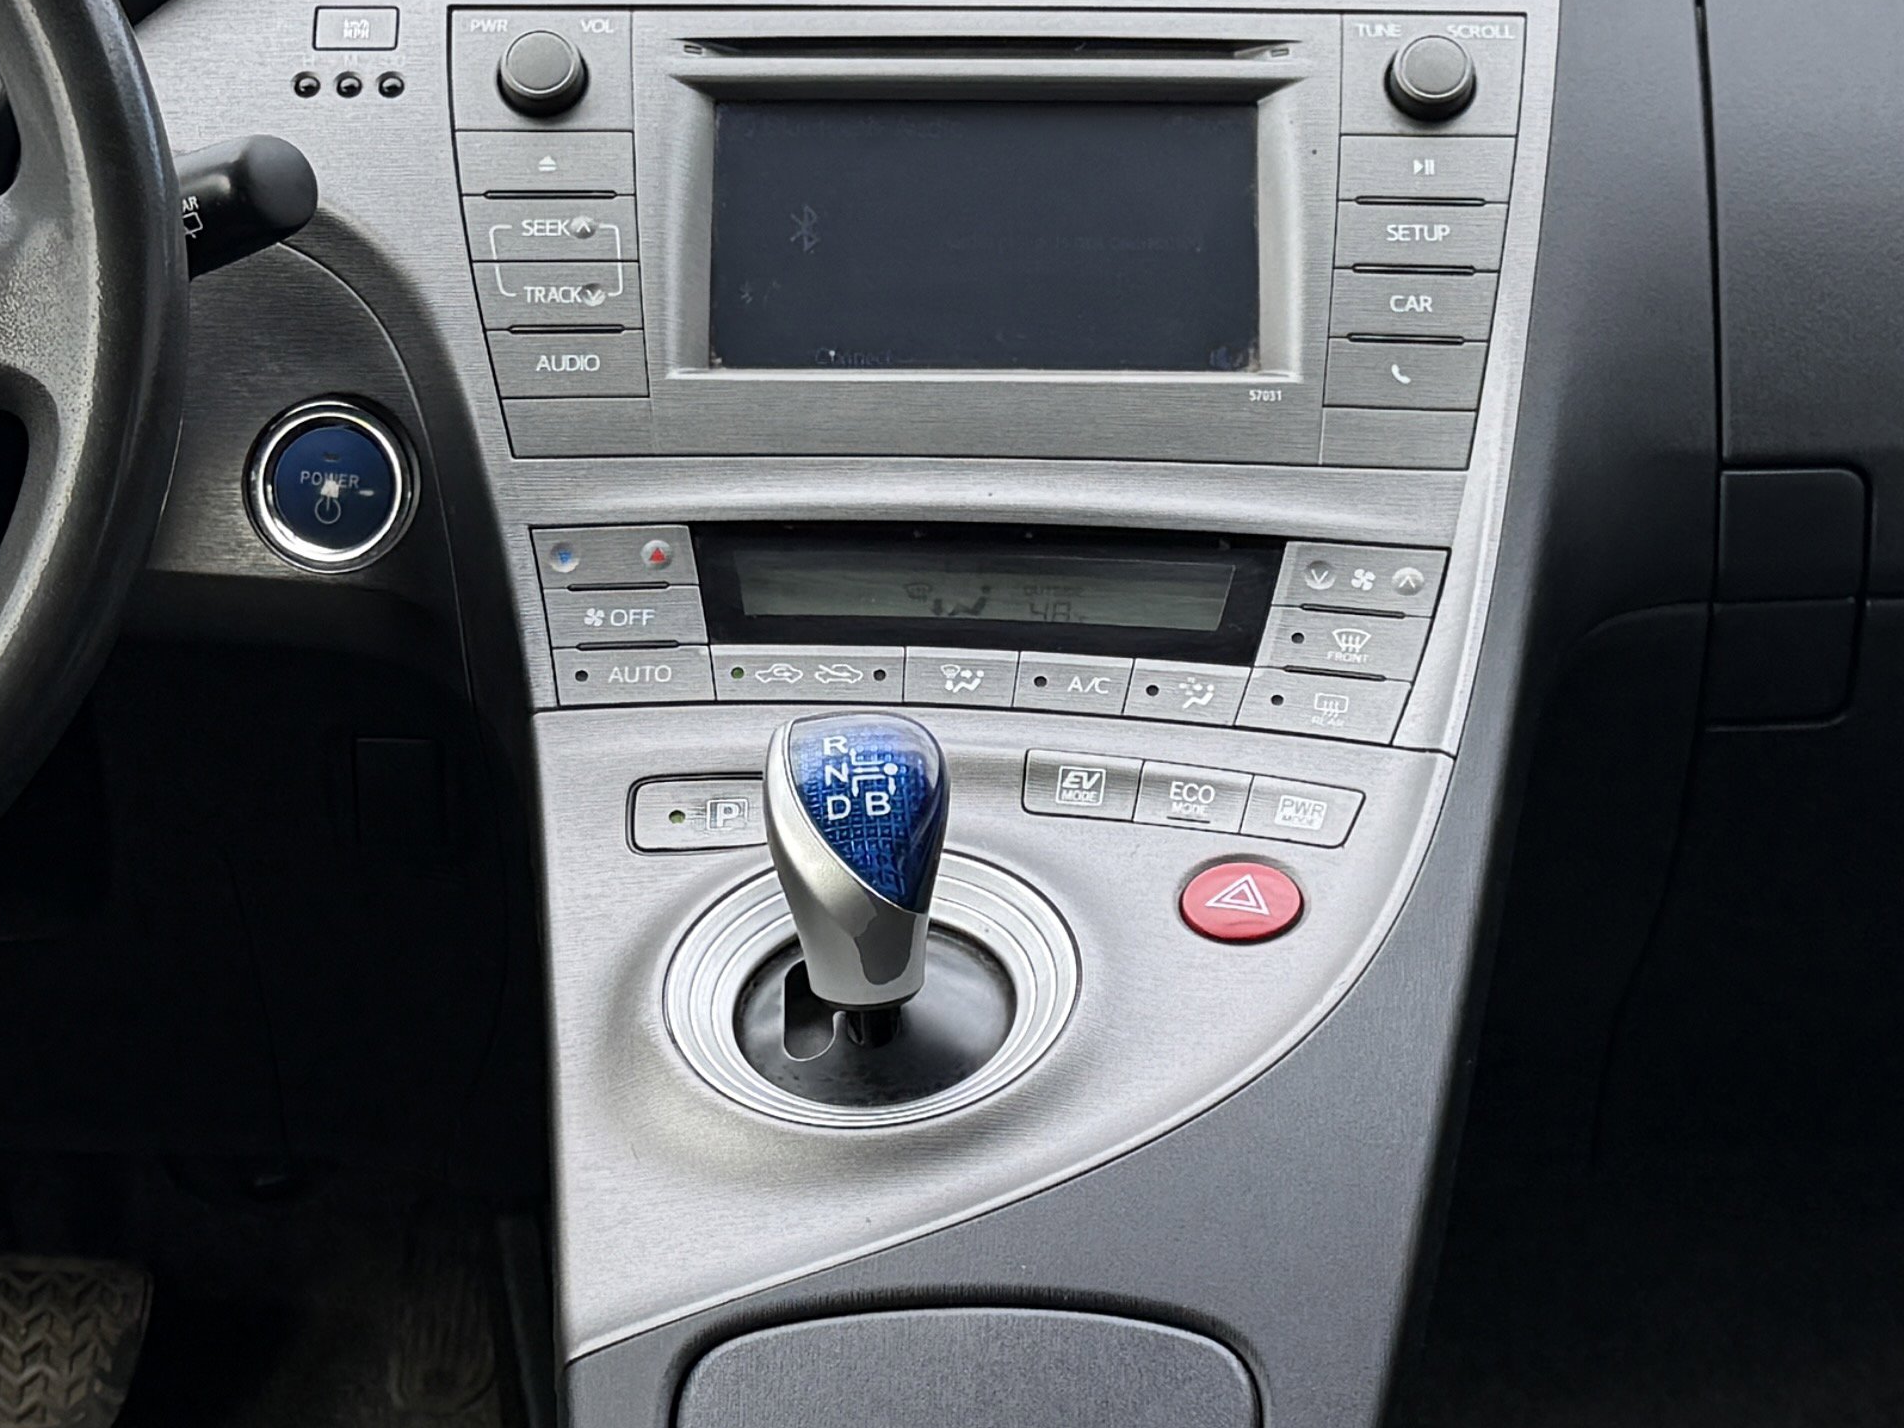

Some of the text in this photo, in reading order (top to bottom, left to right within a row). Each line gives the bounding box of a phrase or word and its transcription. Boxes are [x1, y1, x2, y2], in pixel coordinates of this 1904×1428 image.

[469, 19, 509, 33] PWR
[580, 19, 615, 33] VOL
[1355, 24, 1402, 38] TUNE
[1446, 24, 1515, 40] SCROLL
[520, 219, 571, 237] SEEK
[1385, 224, 1451, 242] SETUP
[523, 286, 582, 304] TRACK
[1389, 295, 1433, 313] CAR
[535, 354, 601, 372] AUDIO
[1248, 390, 1283, 402] 57031
[299, 470, 360, 489] POWER
[610, 608, 656, 627] OFF
[1326, 652, 1370, 664] FRONT
[607, 665, 673, 684] AUTO
[1067, 677, 1111, 696] A/C
[823, 735, 848, 757] R
[825, 763, 849, 786] N
[1061, 772, 1102, 789] EV
[1060, 789, 1099, 804] MODE
[1169, 781, 1216, 804] ECO
[826, 794, 852, 822] D
[864, 790, 892, 817] B
[1171, 803, 1209, 817] MODE
[1280, 798, 1326, 817] PWR
[716, 802, 741, 828] P
